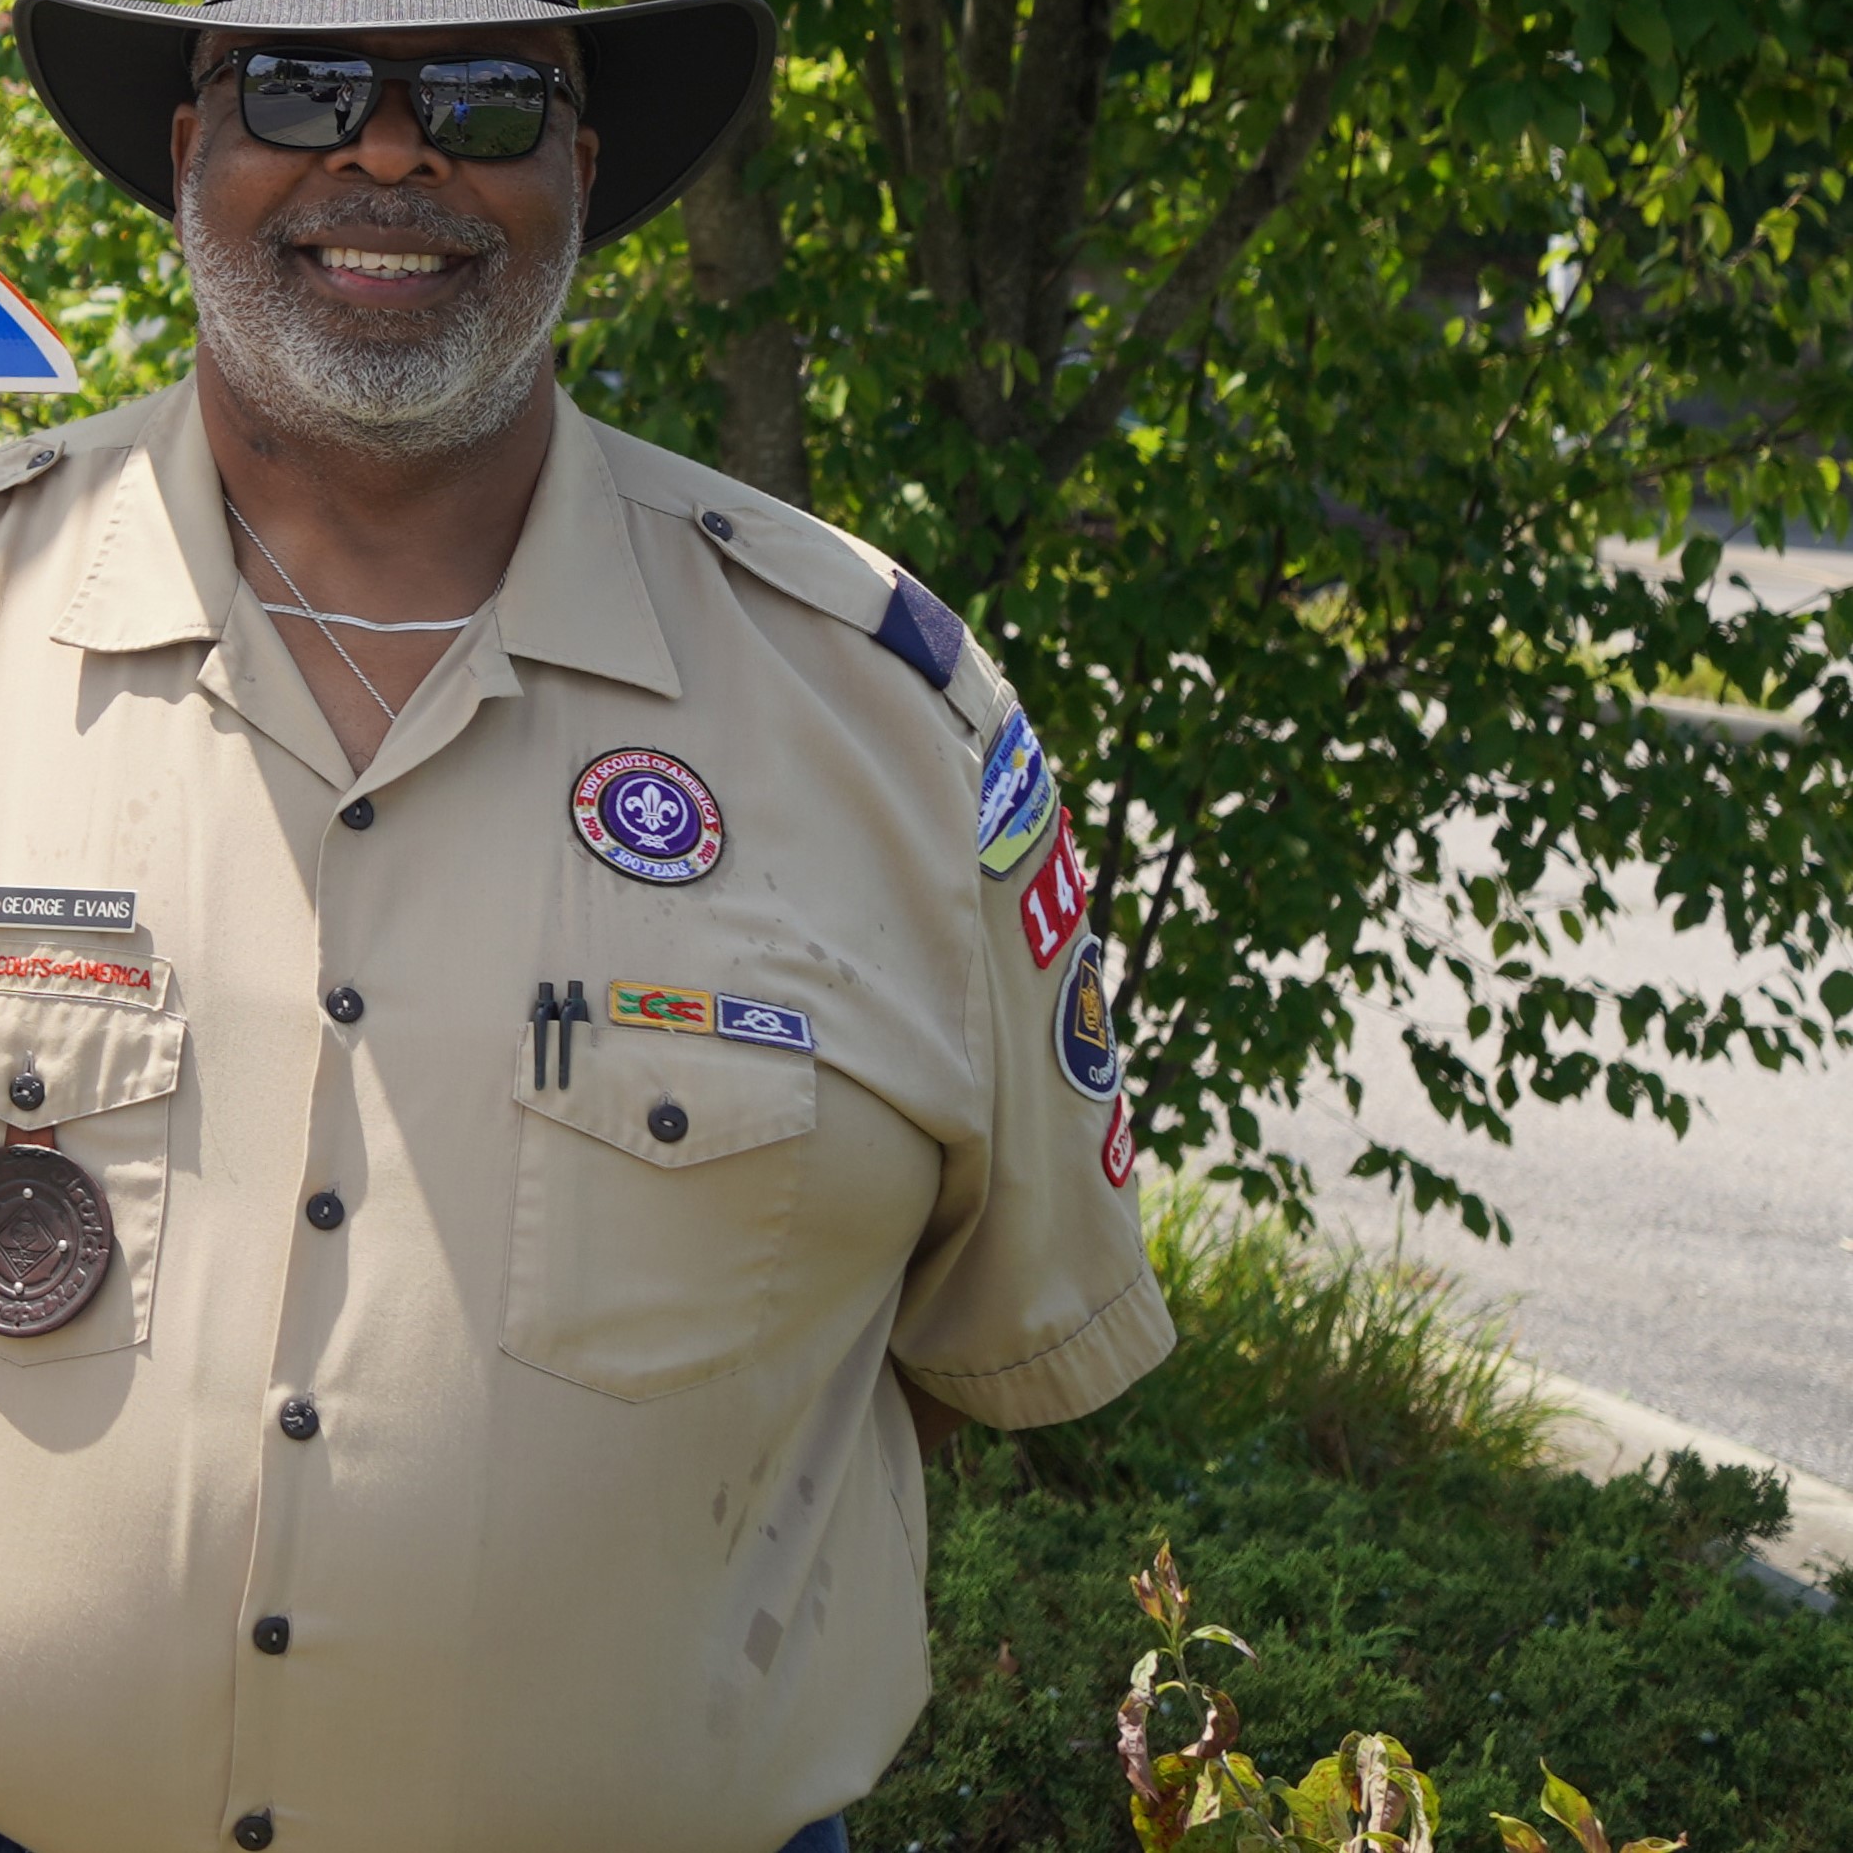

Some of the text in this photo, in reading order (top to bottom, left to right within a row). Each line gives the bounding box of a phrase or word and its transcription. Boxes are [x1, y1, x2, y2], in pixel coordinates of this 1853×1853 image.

[580, 773, 601, 799] BOY
[596, 754, 650, 777] SCOUTS
[666, 766, 718, 824] AMERICA
[980, 762, 1003, 803] RIDGE
[581, 816, 604, 841] 1910
[615, 849, 690, 877] 100 YEARS
[697, 839, 717, 865] 2010
[2, 896, 131, 919] GEORGE EVANS
[70, 958, 151, 991] AMERICA
